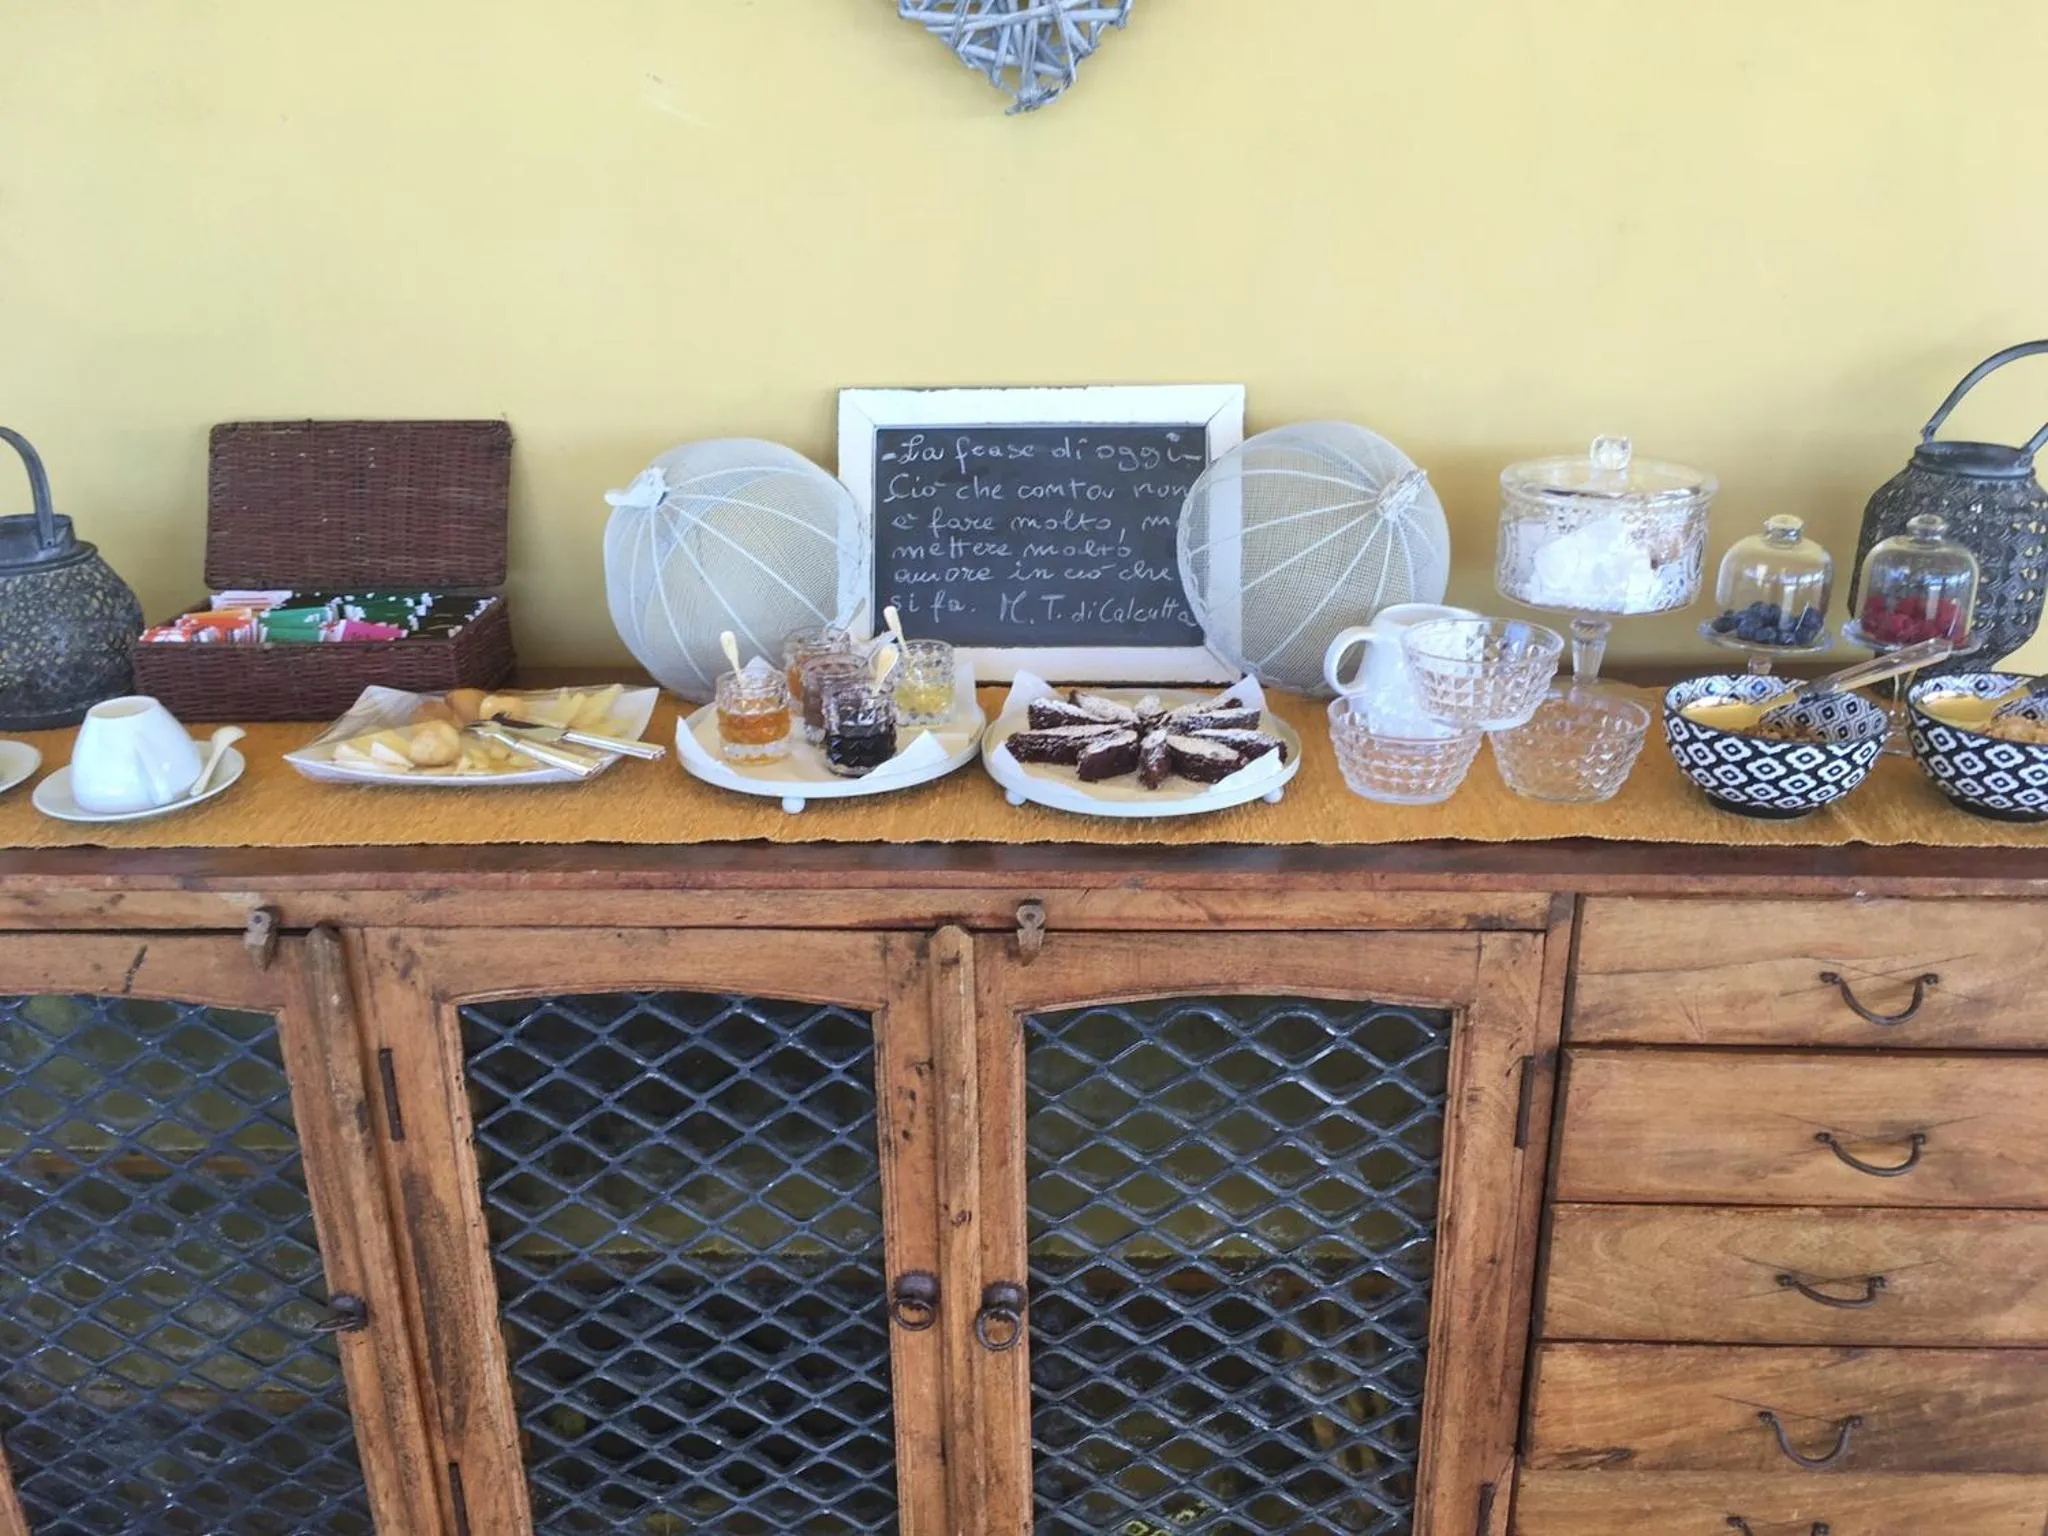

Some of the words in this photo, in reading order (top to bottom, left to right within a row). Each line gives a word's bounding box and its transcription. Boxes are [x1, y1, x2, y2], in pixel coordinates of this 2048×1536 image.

[1052, 436, 1088, 461] di
[883, 473, 946, 503] Ciò
[956, 475, 1004, 500] che
[1017, 478, 1115, 500] conta
[928, 507, 996, 539] fare
[891, 536, 1012, 560] mettere
[894, 566, 995, 584] amore
[1007, 560, 1055, 582] in
[1118, 559, 1175, 583] che
[1098, 597, 1198, 628] Calcutta
